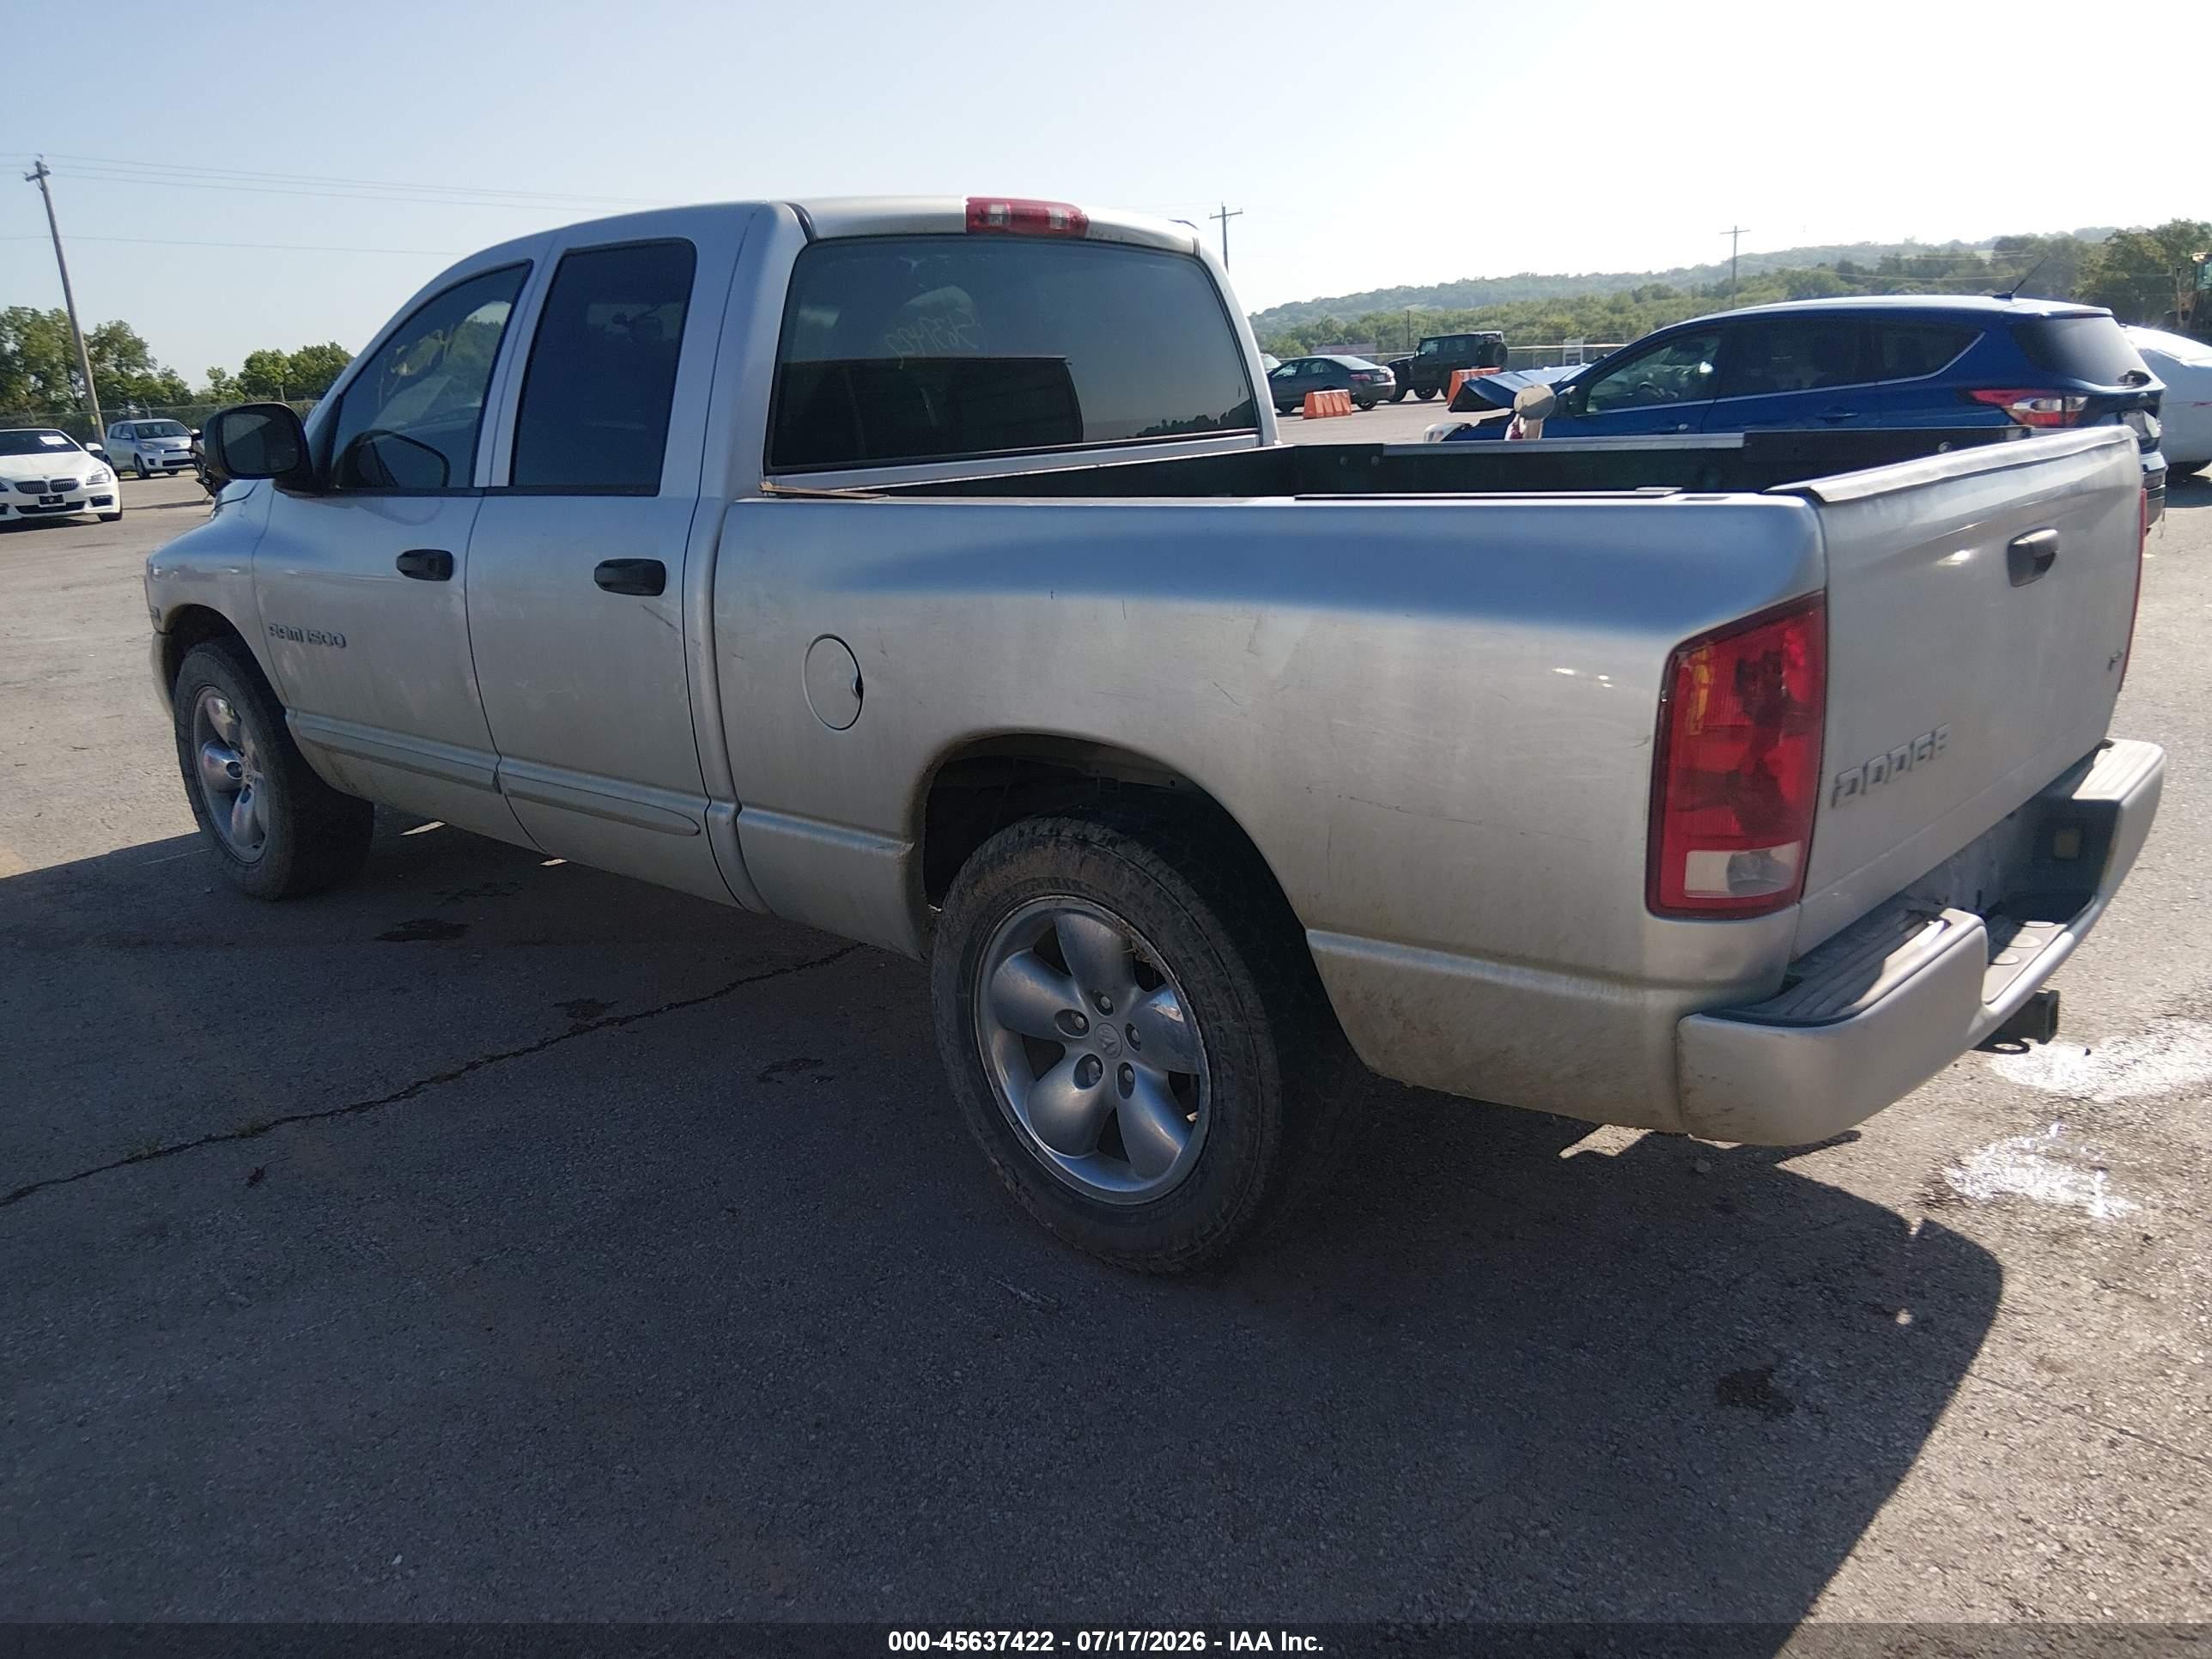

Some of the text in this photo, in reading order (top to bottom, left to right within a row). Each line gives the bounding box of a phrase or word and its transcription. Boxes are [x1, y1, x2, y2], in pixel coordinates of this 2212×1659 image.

[269, 622, 347, 649] RAM 1500
[1831, 721, 1952, 810] DODGE
